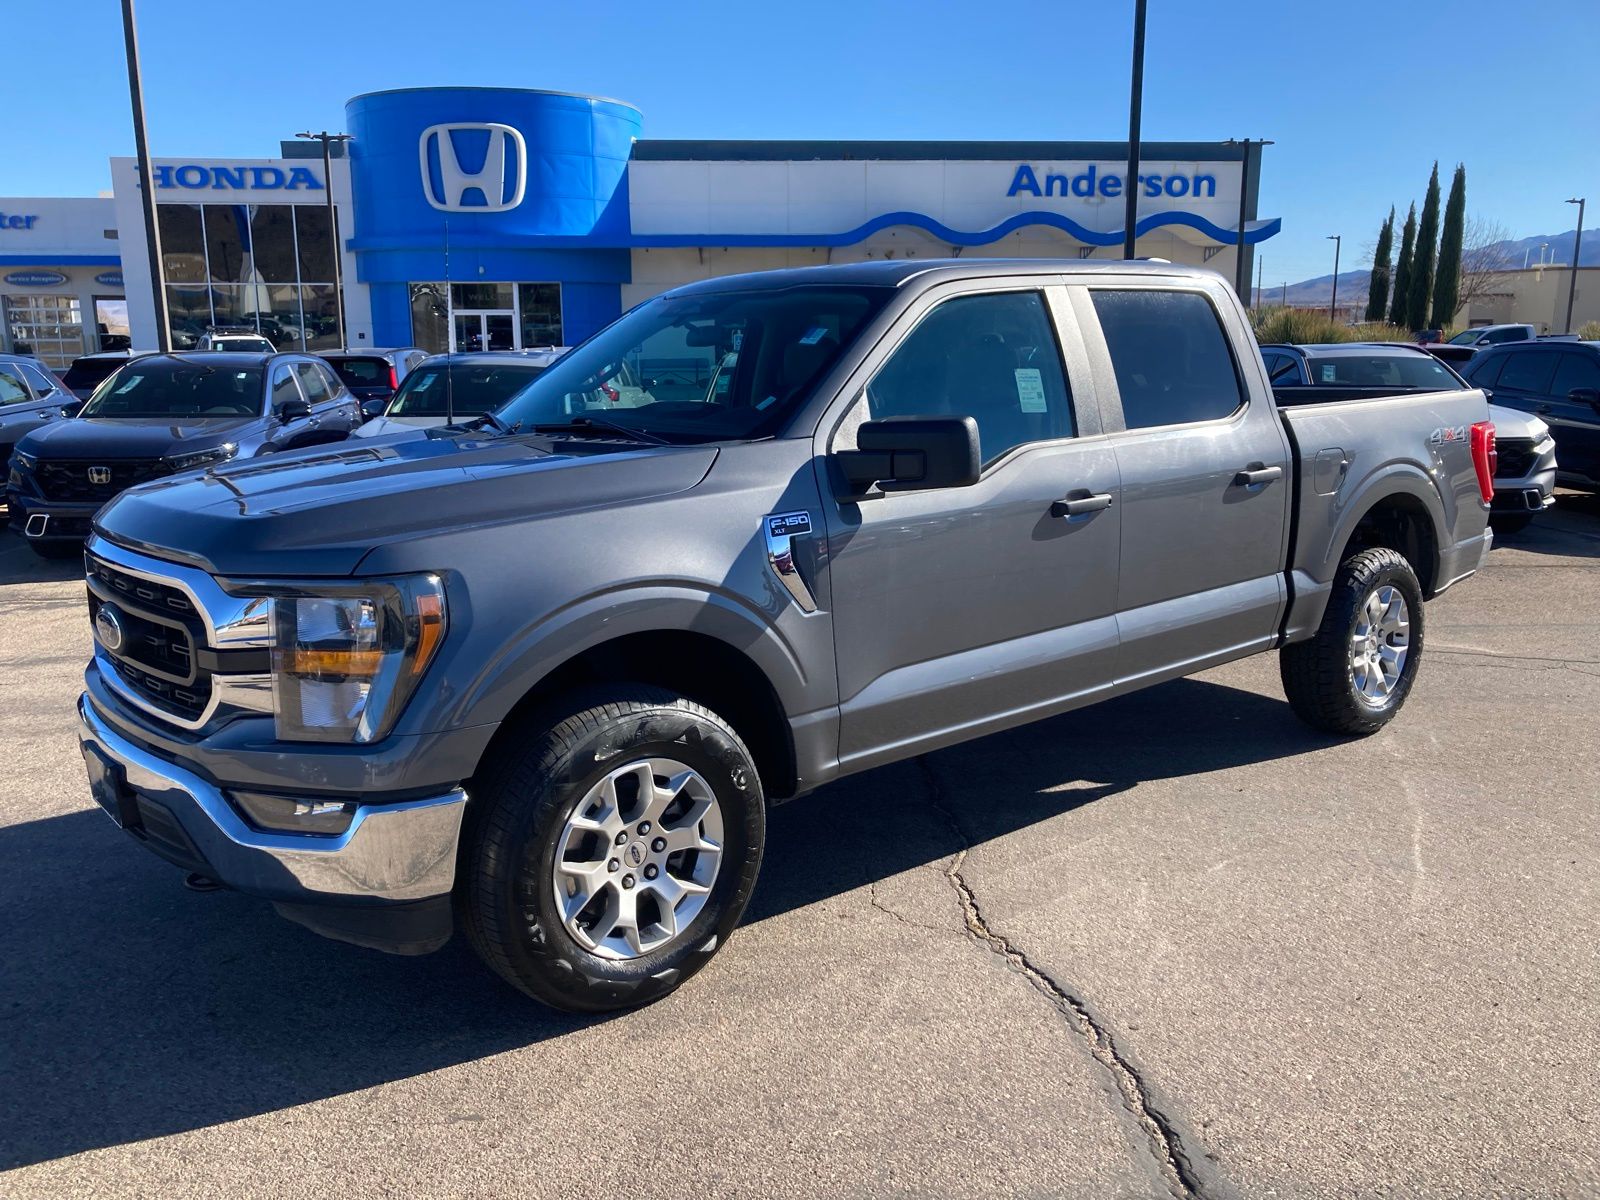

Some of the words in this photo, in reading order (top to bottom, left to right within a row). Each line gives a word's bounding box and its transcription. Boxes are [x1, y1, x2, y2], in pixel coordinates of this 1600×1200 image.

[1006, 164, 1216, 197] Andeson
[770, 515, 808, 528] F-150
[774, 527, 786, 535] XLT
